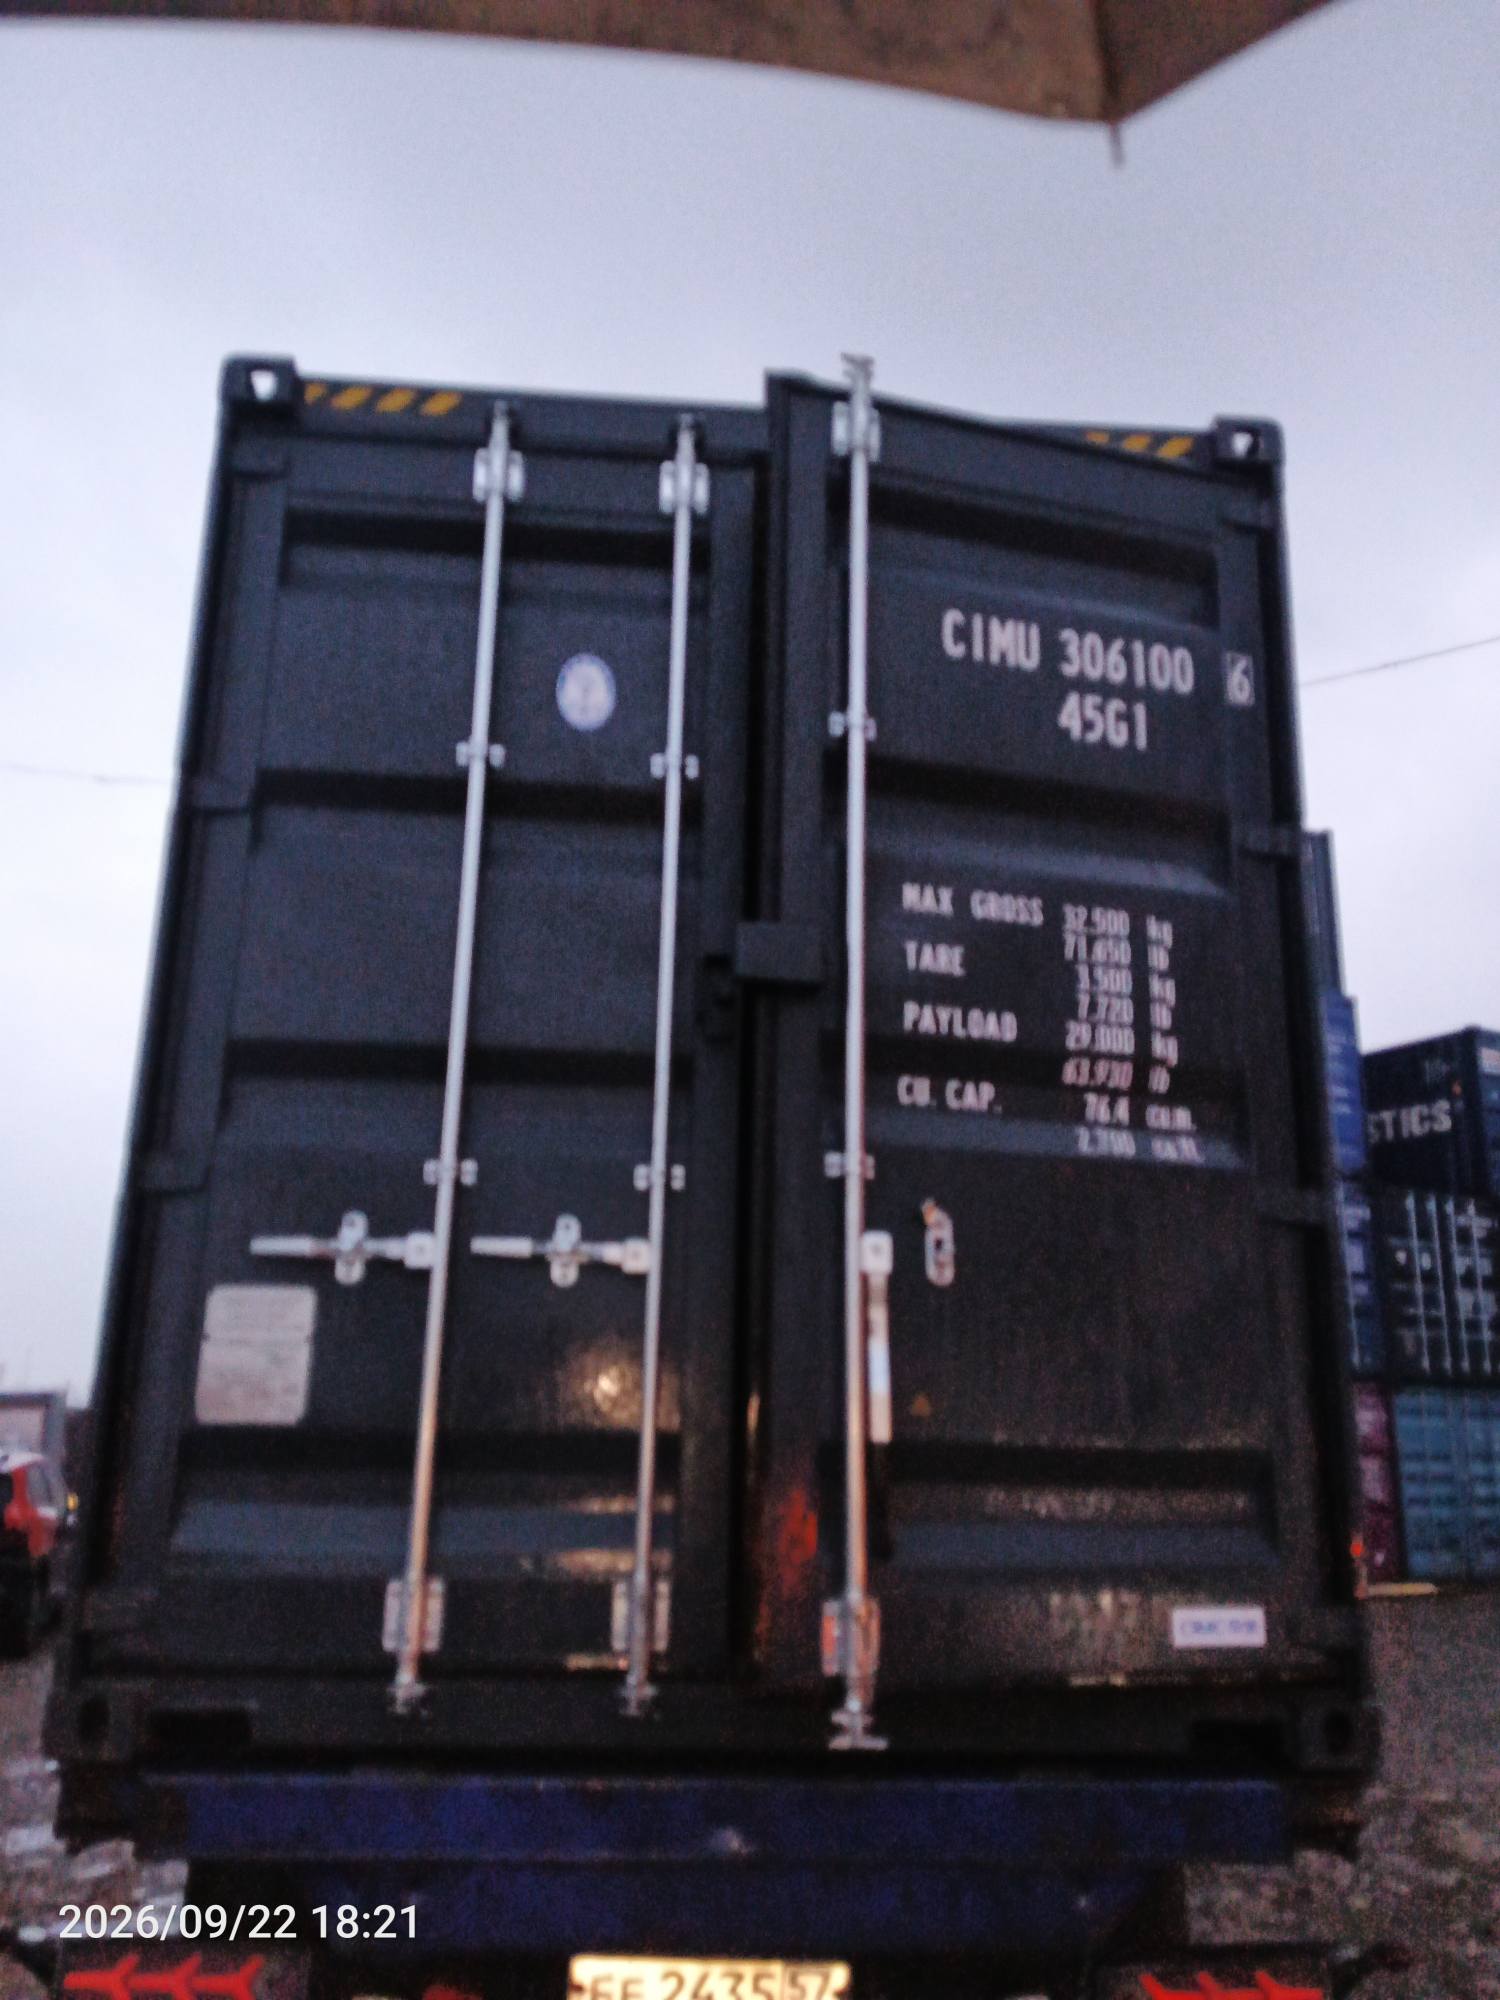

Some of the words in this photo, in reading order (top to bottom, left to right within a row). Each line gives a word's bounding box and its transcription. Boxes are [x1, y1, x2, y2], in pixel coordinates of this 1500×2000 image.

[941, 607, 1041, 672] CIMU
[1059, 628, 1195, 695] 306100
[1226, 653, 1254, 706] 6
[1057, 690, 1148, 751] 45G1
[902, 882, 953, 917] MAX
[970, 889, 1043, 926] GROSS
[905, 940, 966, 977] TARE
[903, 1000, 1018, 1043] PAYLOAD
[896, 1074, 937, 1107] CU.
[945, 1078, 1003, 1113] CAP.
